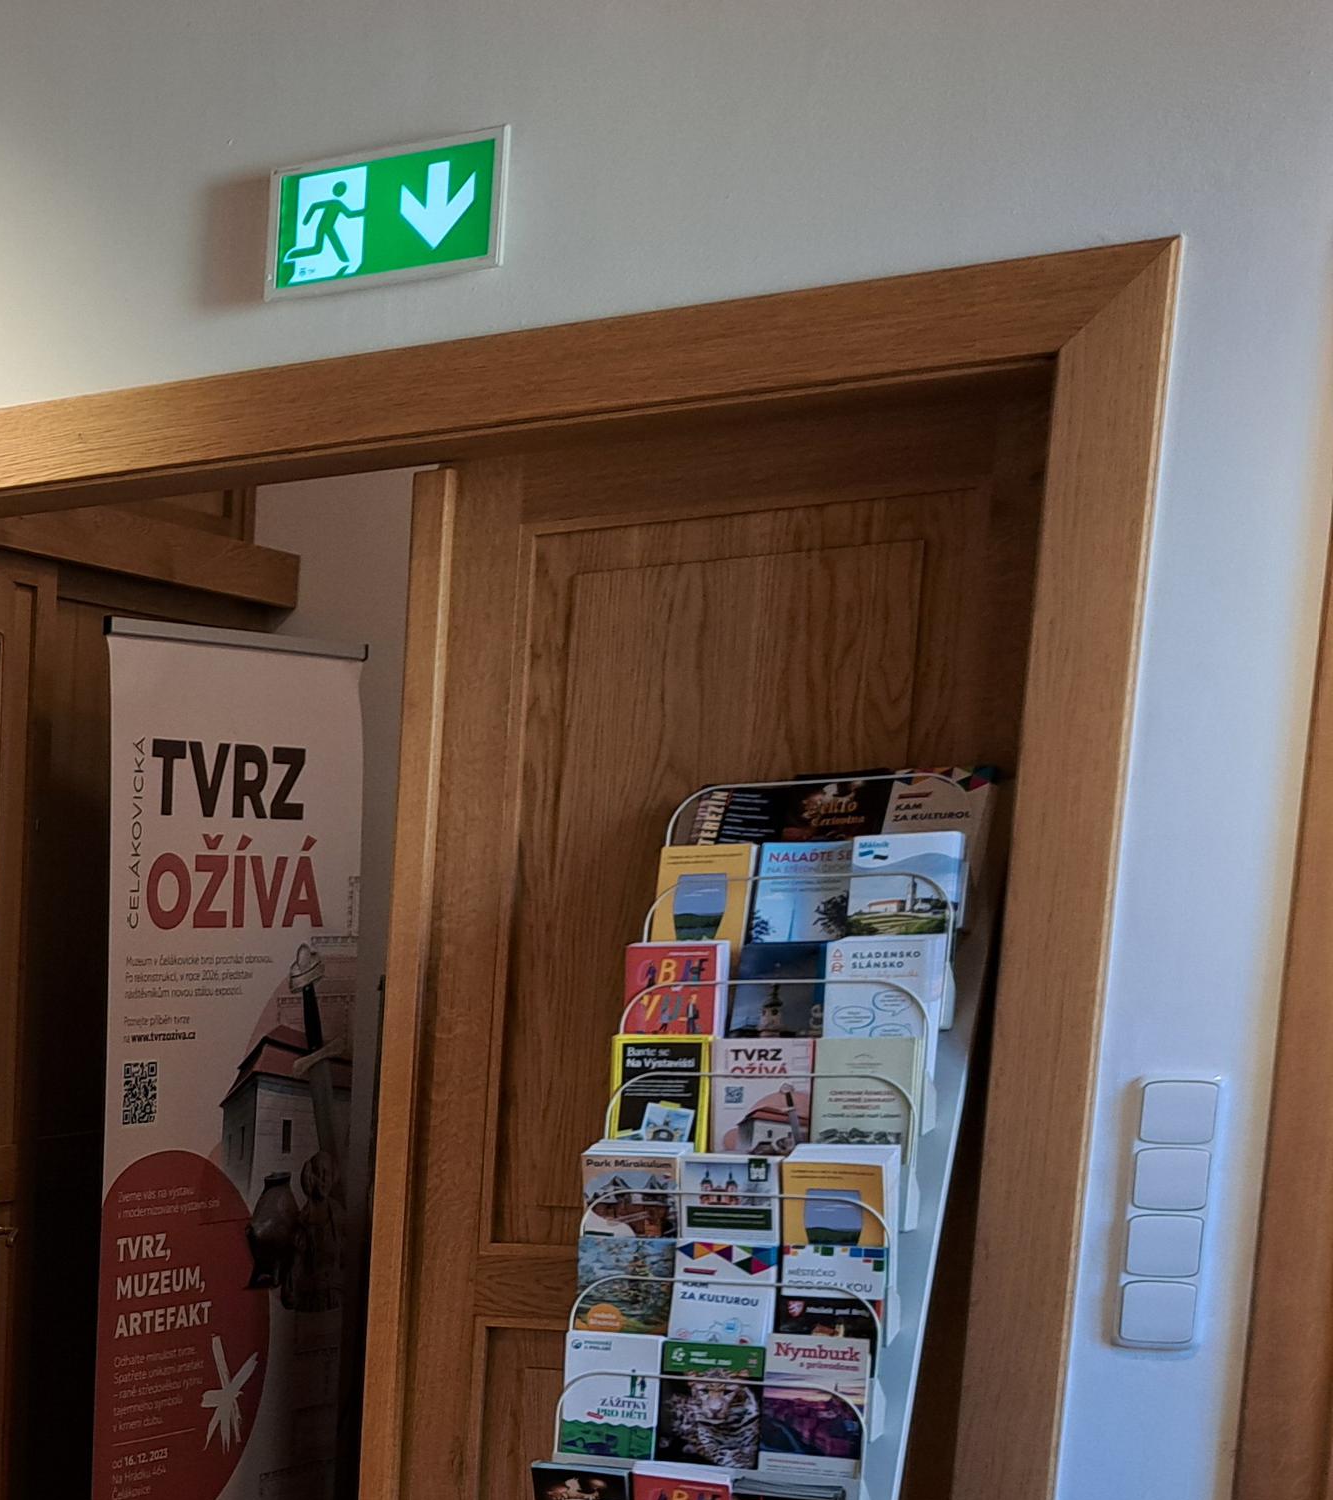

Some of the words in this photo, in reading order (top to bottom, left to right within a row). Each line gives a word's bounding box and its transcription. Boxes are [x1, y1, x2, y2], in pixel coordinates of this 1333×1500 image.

[151, 738, 307, 821] TVRZ
[127, 736, 146, 930] ČELÁKOVICKÁ
[146, 832, 324, 932] OŽÍVÁ
[852, 950, 921, 960] KLADENSKO
[852, 959, 904, 969] SLÁNSKO
[131, 1029, 196, 1043] www.tvrzoziva.cz
[730, 1048, 782, 1061] TVRZ
[586, 1158, 611, 1168] Park
[116, 1233, 171, 1262] TVRZ,
[116, 1266, 206, 1300] MUZEUM,
[680, 1290, 697, 1301] ZA
[699, 1292, 759, 1307] KULTUROU
[114, 1301, 213, 1339] ARTEFAKT
[774, 1342, 860, 1362] Nymburk
